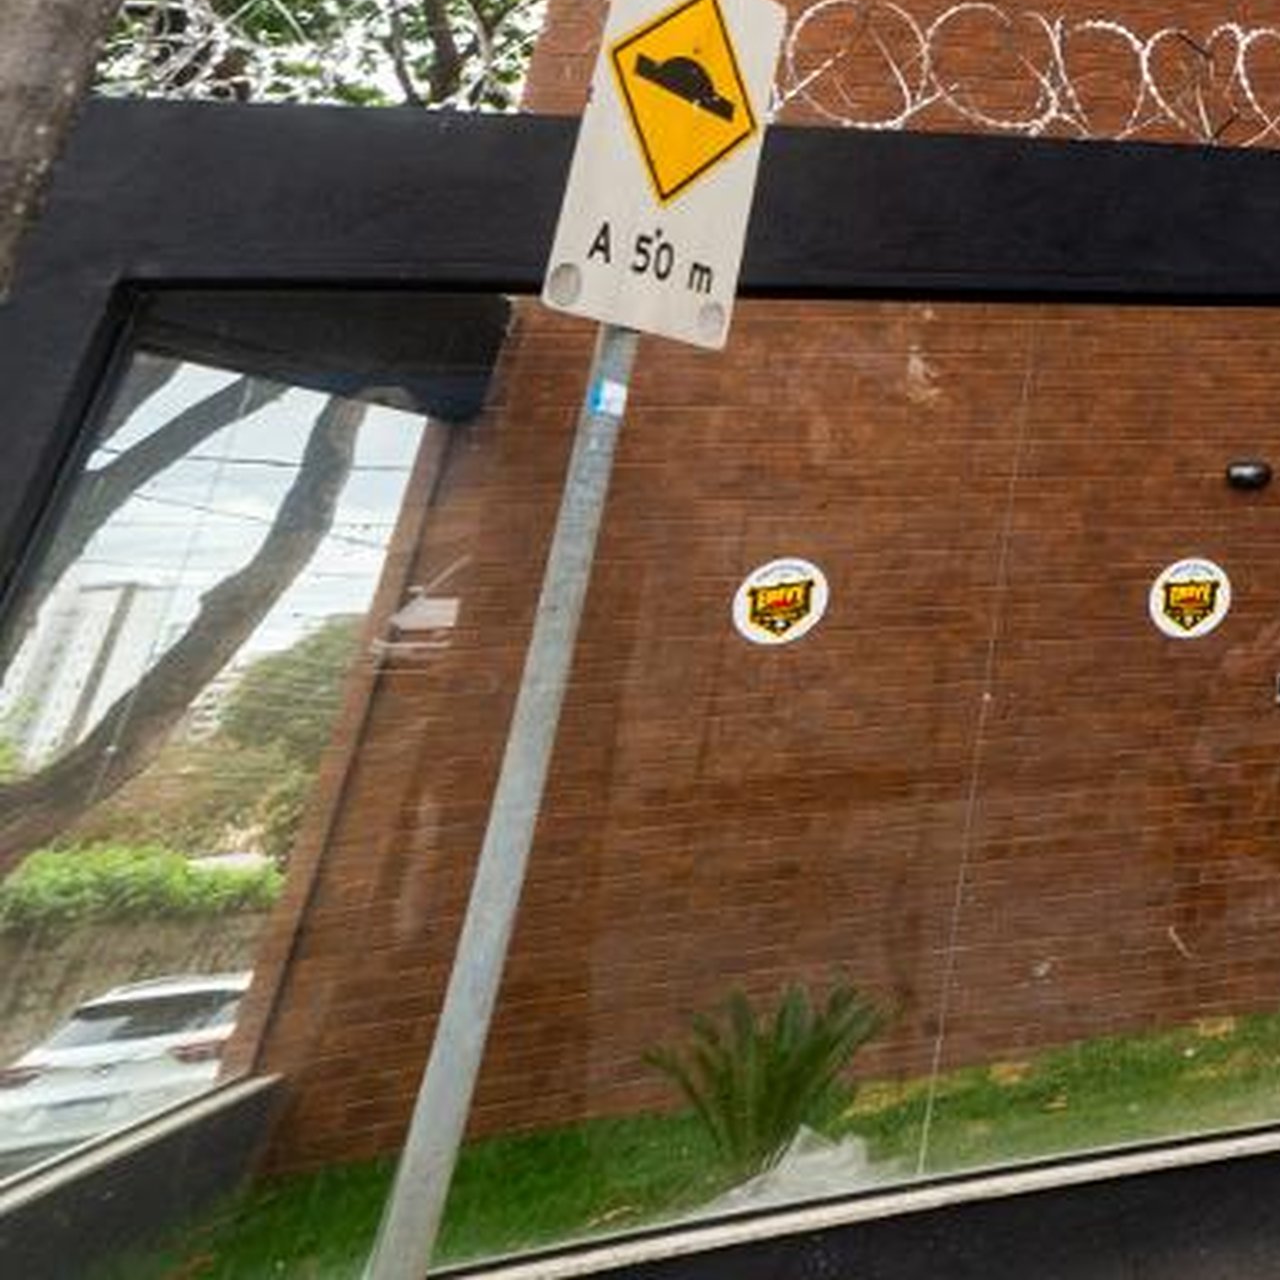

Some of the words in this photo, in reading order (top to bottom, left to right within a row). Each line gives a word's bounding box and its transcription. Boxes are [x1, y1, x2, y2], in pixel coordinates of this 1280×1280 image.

[587, 222, 611, 263] A
[631, 234, 675, 281] 50
[688, 262, 713, 294] m
